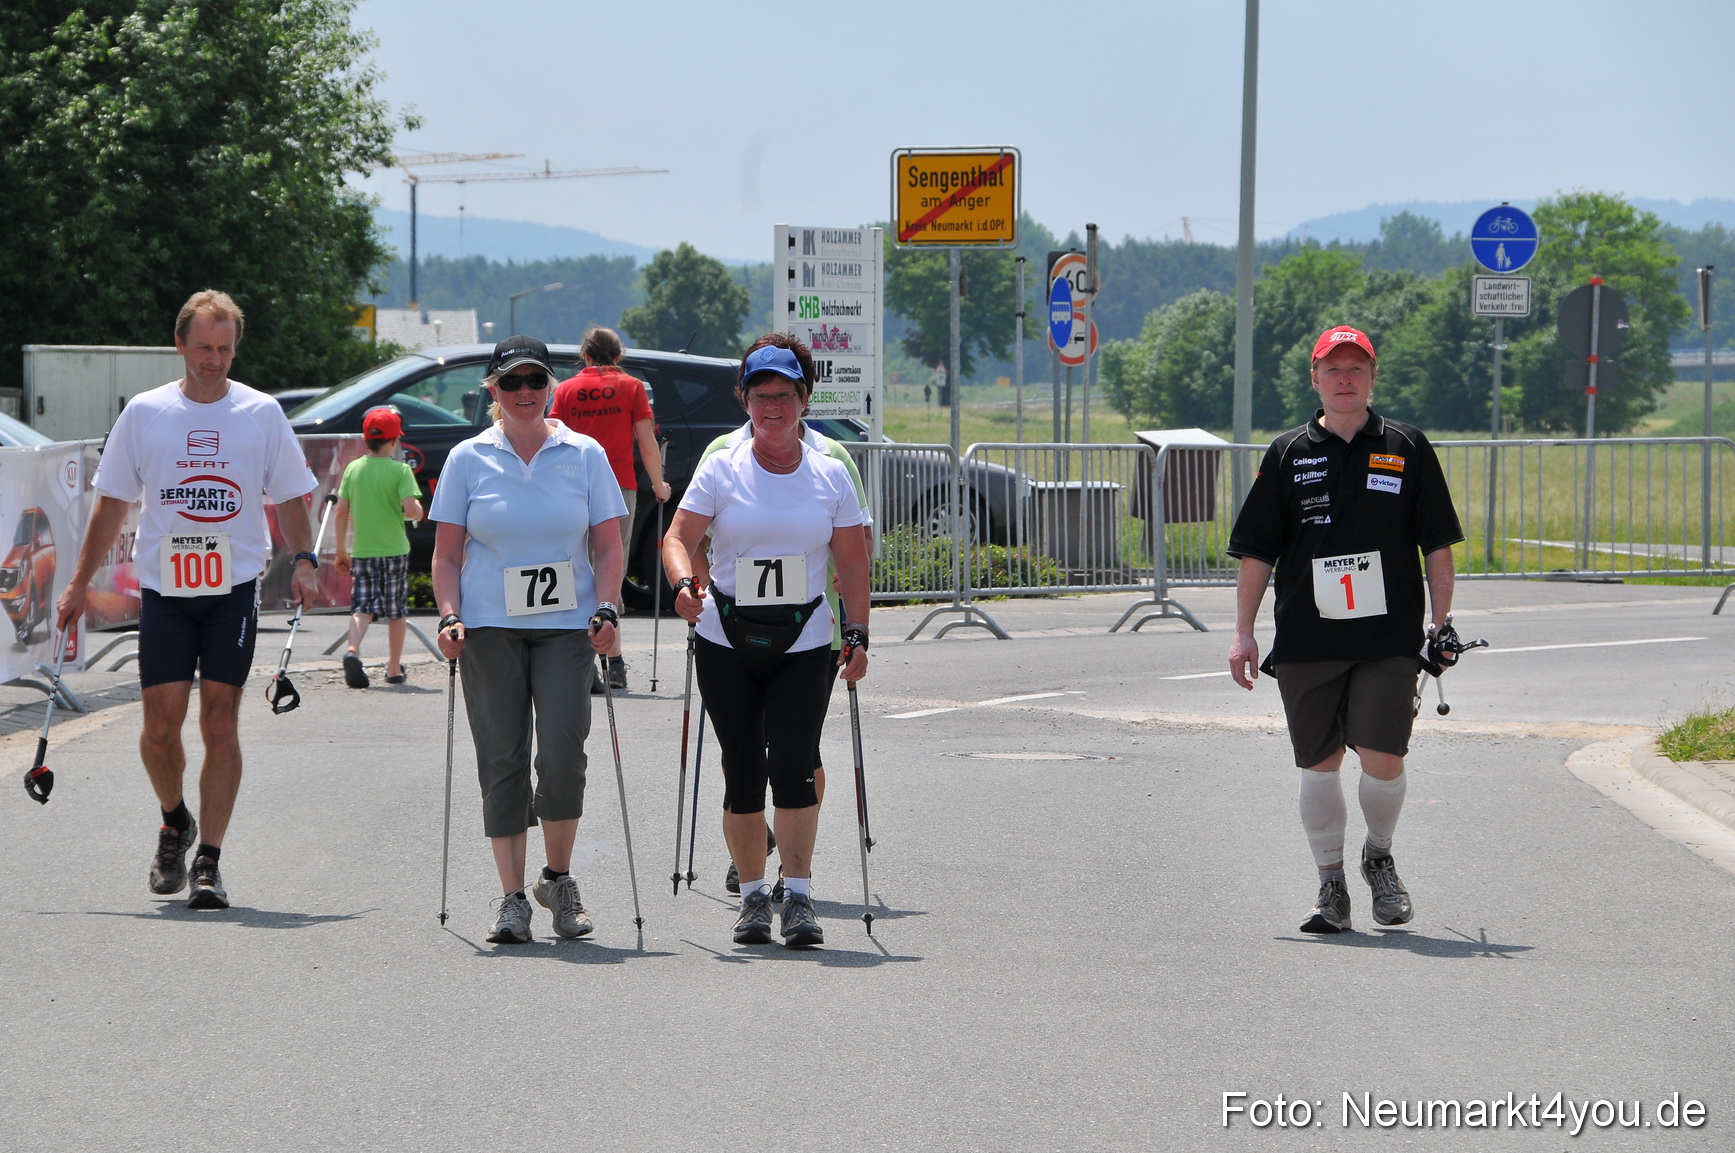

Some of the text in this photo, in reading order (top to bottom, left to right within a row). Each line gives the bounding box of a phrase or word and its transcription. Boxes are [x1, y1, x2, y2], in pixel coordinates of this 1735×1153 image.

[908, 165, 1004, 193] Sengenthal
[921, 194, 991, 211] am Anger
[905, 220, 927, 232] Kreis
[931, 220, 973, 232] Neumarkt
[821, 230, 862, 245] HOLZAMMER
[821, 262, 862, 277] HOLZAMMER
[1484, 281, 1521, 290] Landwirt-
[1479, 292, 1524, 301] schaftlicher
[799, 295, 862, 320] SHB Holzfachmarkt
[1479, 302, 1525, 311] Verkehr frei
[501, 348, 515, 357] Audi
[576, 386, 615, 402] SCO
[571, 405, 622, 419] Gymnastik
[176, 461, 229, 469] SEAT
[1293, 456, 1328, 466] Cellagon
[1302, 469, 1328, 481] killtec
[1379, 479, 1399, 489] victory
[228, 490, 235, 499] &
[171, 536, 203, 545] MEYER
[1324, 557, 1355, 568] MEYER
[170, 552, 223, 589] 100
[1324, 565, 1357, 574] WERBUNG
[753, 559, 784, 598] 71
[520, 566, 559, 608] 72
[1340, 573, 1355, 610] 1
